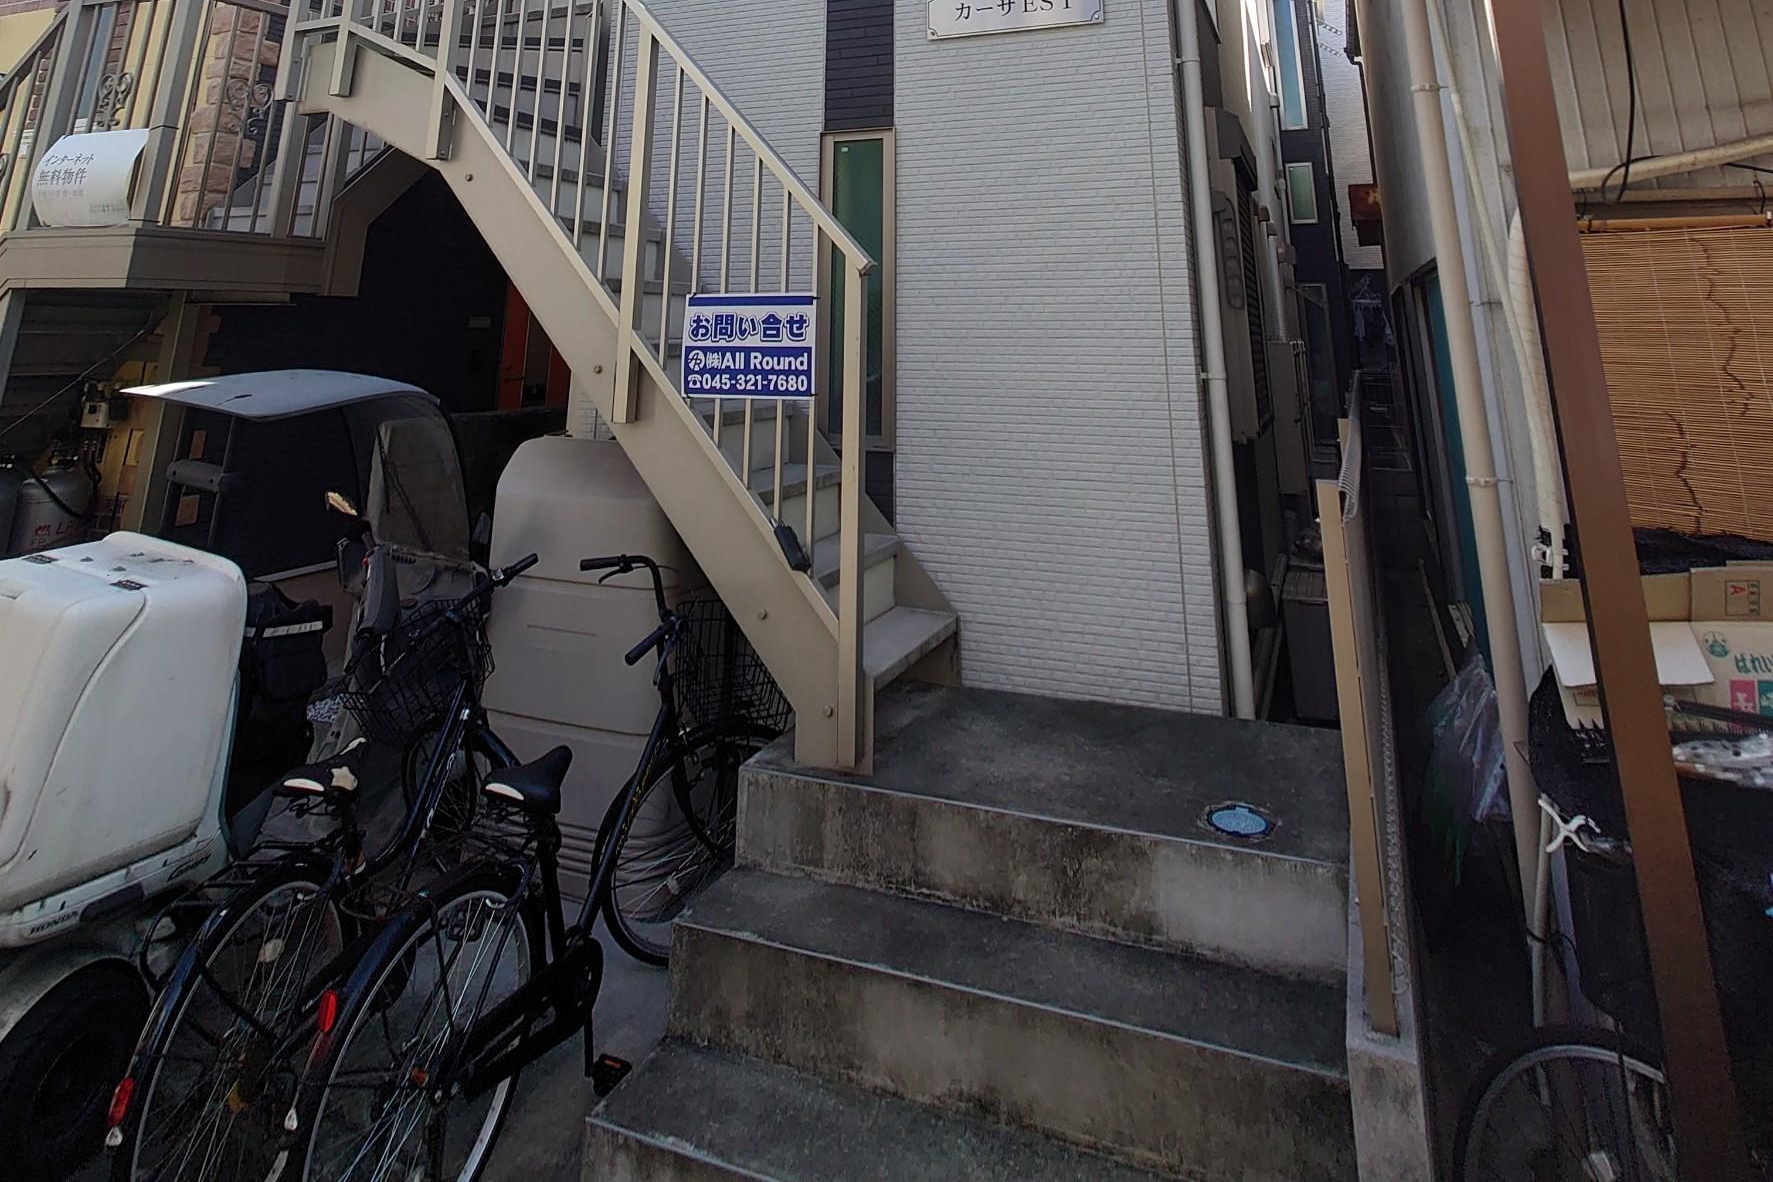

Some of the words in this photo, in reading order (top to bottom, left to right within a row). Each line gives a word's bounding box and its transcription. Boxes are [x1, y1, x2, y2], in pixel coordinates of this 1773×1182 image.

[44, 152, 95, 167] インターネット
[37, 168, 87, 186] 無料物件
[689, 312, 809, 342] お問い合せ
[750, 351, 808, 371] Round
[702, 374, 808, 392] 045-321-7680
